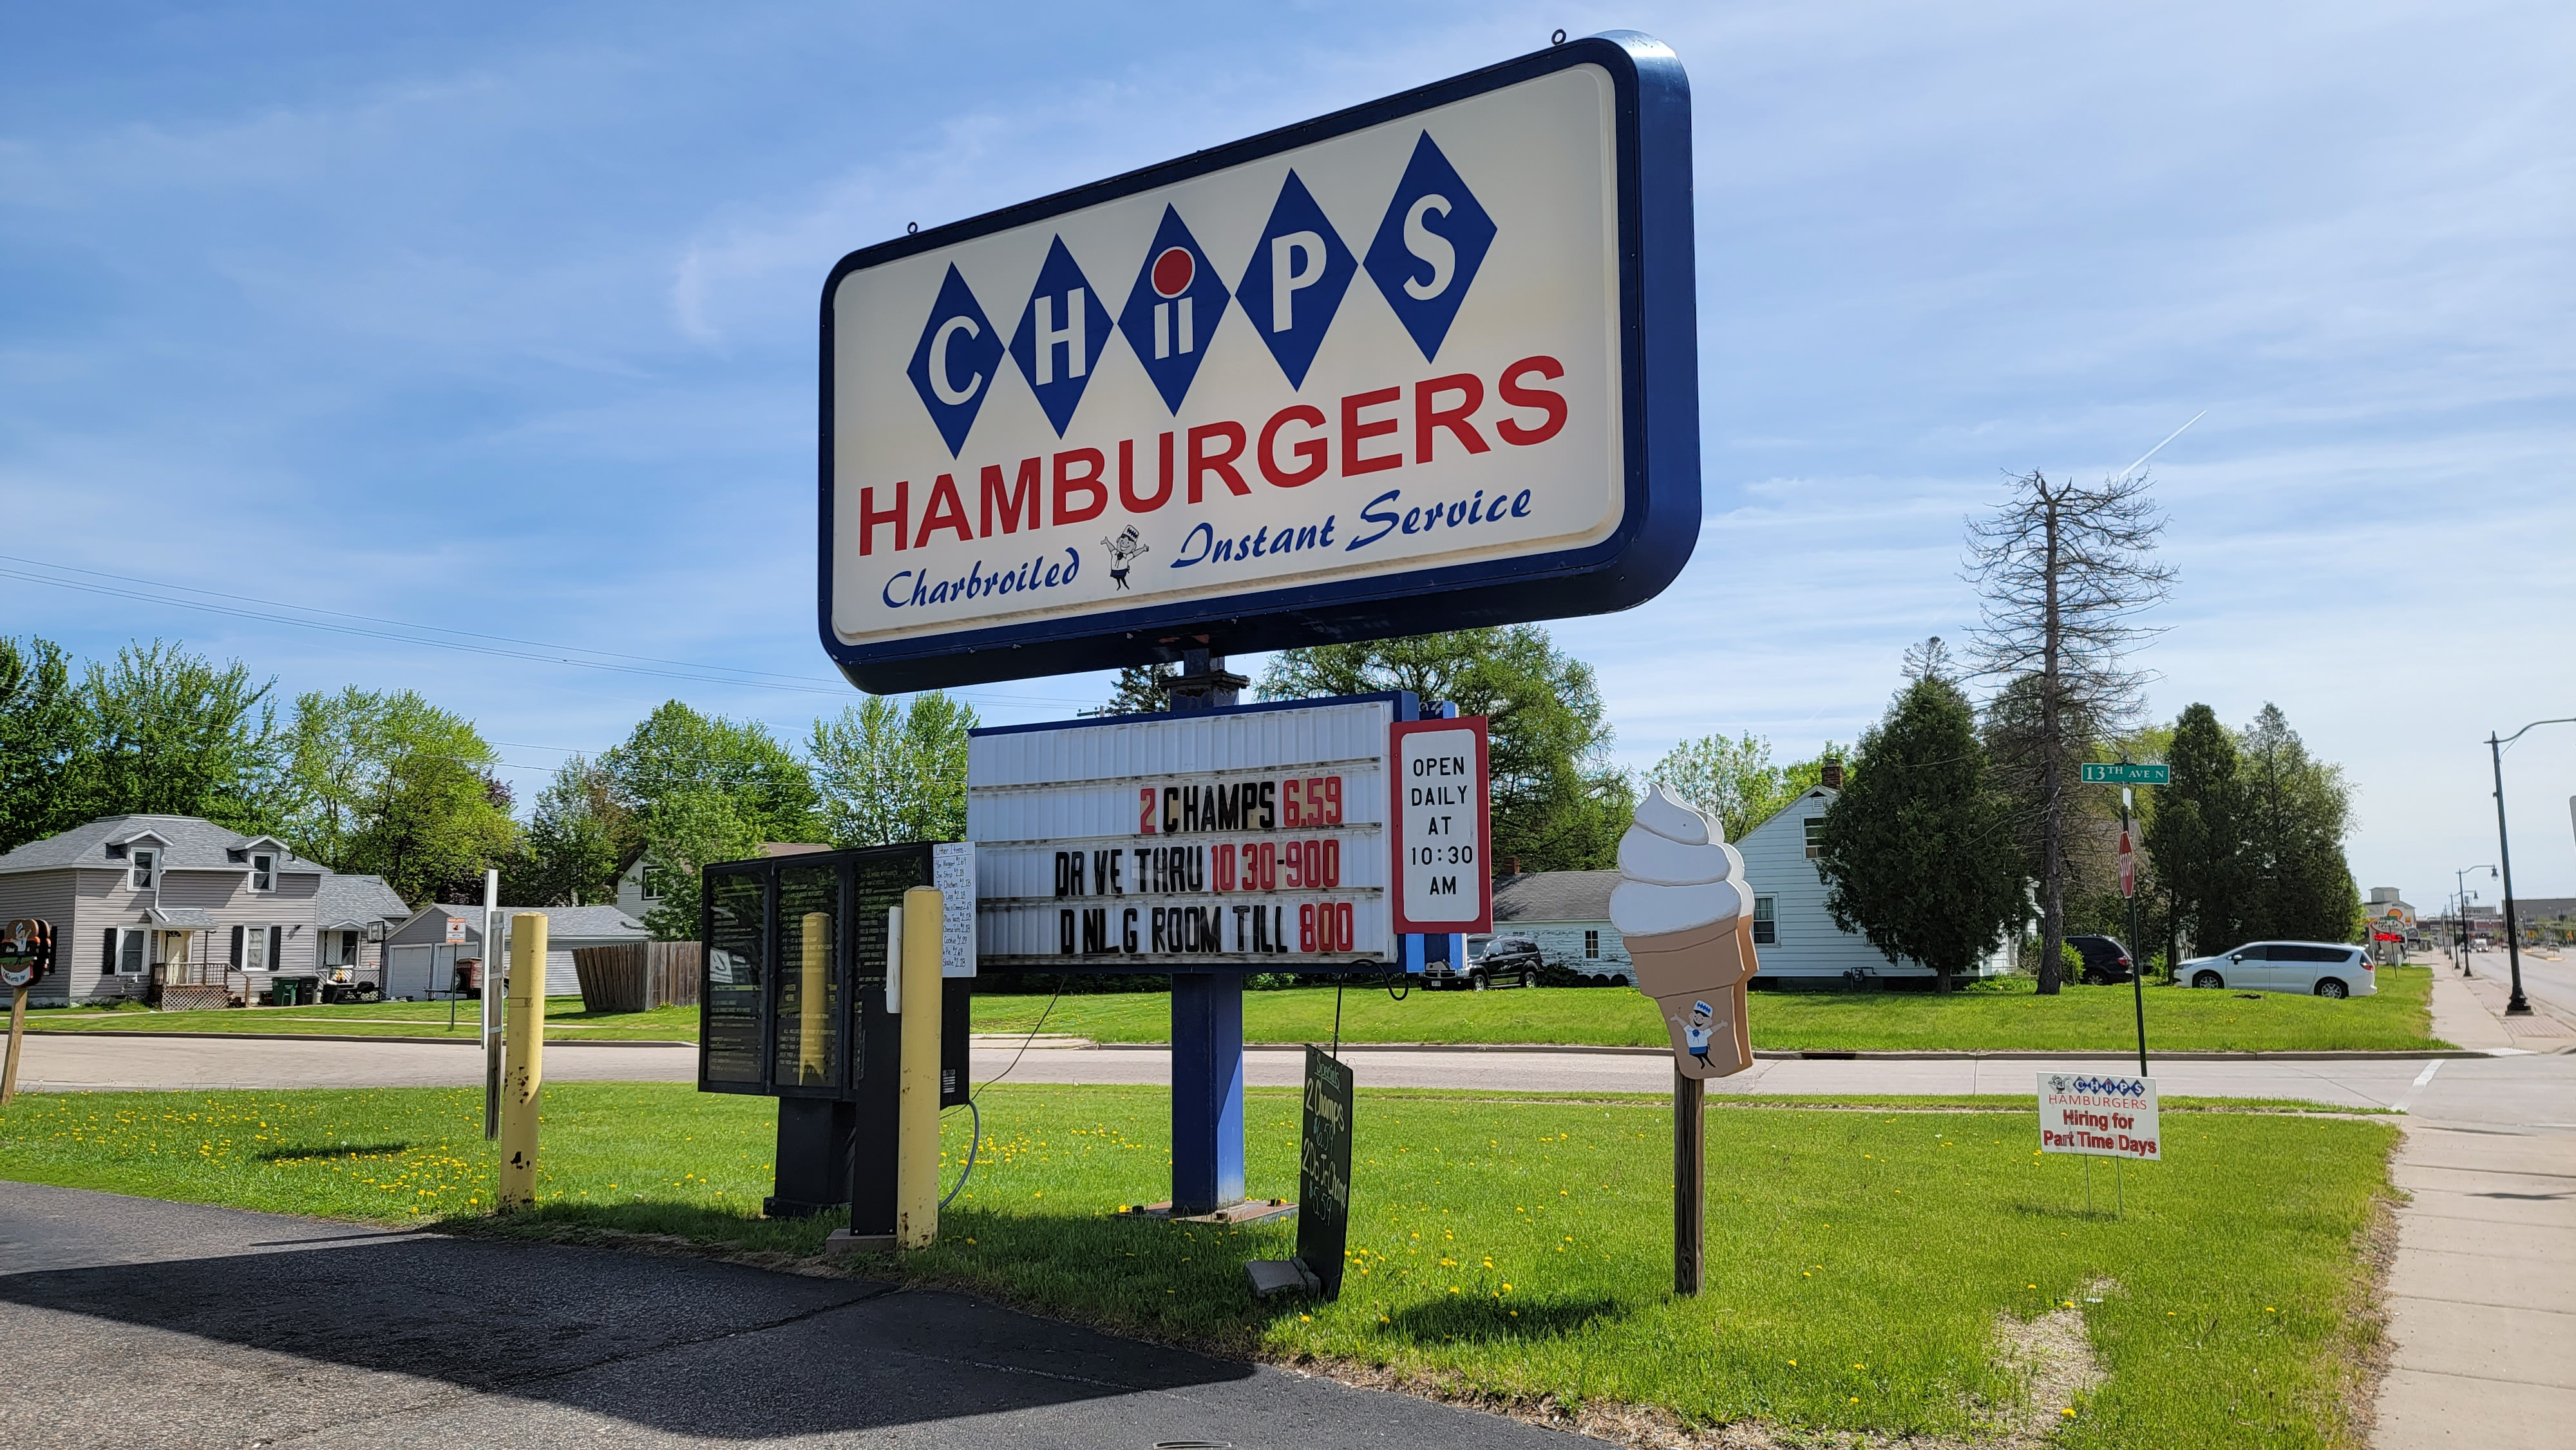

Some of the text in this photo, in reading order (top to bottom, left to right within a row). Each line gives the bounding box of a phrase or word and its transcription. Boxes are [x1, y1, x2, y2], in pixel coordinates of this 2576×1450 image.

[859, 355, 1568, 556] HAMBURGERS
[882, 489, 1532, 609] Charbroiled Instant Service
[1413, 756, 1464, 777] OPEN
[2086, 766, 2123, 780] 13TH
[2155, 770, 2164, 778] N
[1140, 776, 1342, 834] 2 CHAMPS 6.59
[1411, 785, 1468, 807] DAILY
[1428, 816, 1452, 835] AT
[1411, 845, 1473, 865] 10:30
[2119, 852, 2132, 878] STOP
[1134, 845, 1203, 893] THRU
[1430, 876, 1457, 895] AM
[1152, 906, 1222, 953] ROOM
[1233, 905, 1288, 953] TILL
[1299, 902, 1353, 952] 800
[1316, 1053, 1340, 1091] Specials
[1305, 1077, 1345, 1136] 2 Champs
[2049, 1094, 2147, 1110] HAMBURGERS
[2063, 1109, 2135, 1132] Hiring for
[2043, 1130, 2157, 1156] Part Time Days
[1302, 1137, 1309, 1174] 2
[1327, 1161, 1347, 1216] Champs
[1309, 1179, 1332, 1226] $5.59
